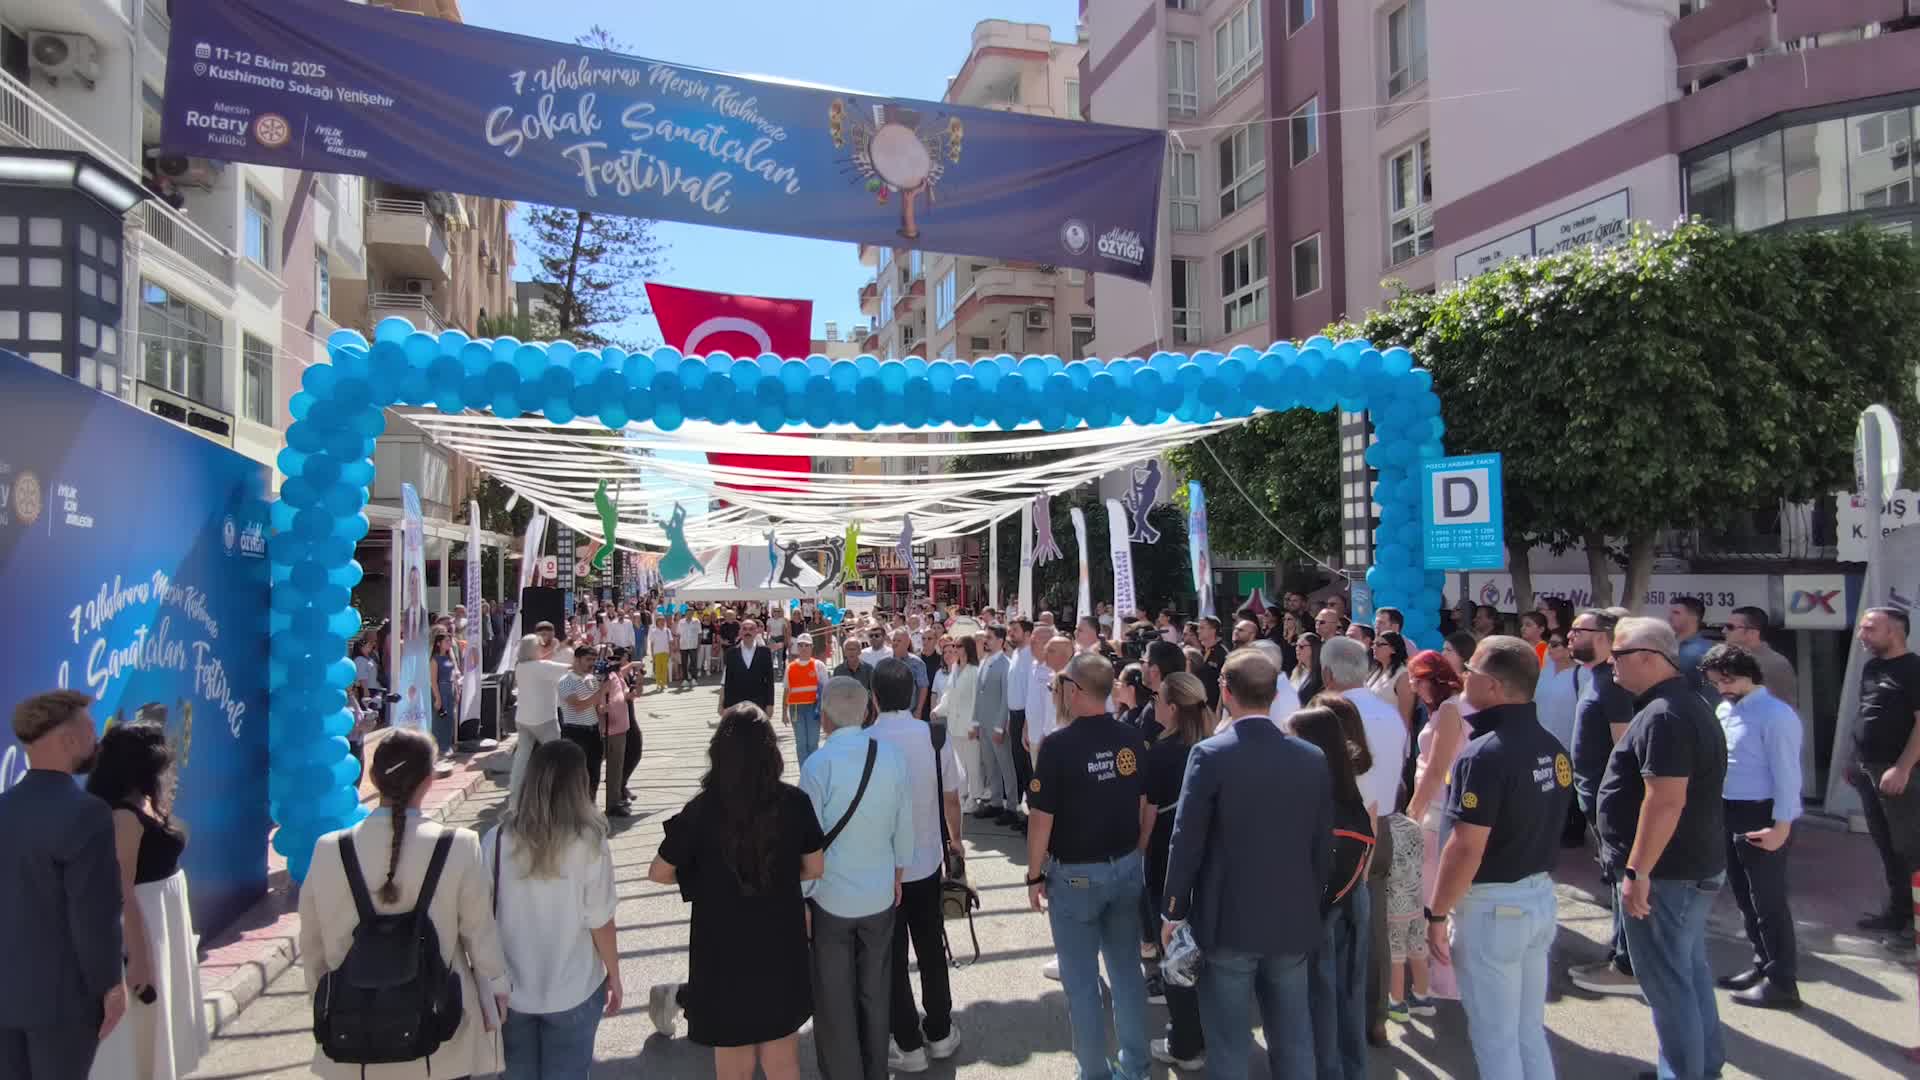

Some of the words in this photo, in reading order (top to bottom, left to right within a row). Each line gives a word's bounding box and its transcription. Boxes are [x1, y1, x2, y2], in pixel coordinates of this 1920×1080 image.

[214, 46, 251, 65] 11-12
[254, 54, 289, 73] Ekim
[291, 61, 327, 79] 2025
[208, 64, 286, 91] Kushimoto
[287, 79, 334, 101] Sokağı
[336, 87, 396, 108] Yenişehir
[648, 63, 711, 101] Mersin
[711, 84, 788, 142] Kushimoto
[185, 110, 249, 137] Rotary
[213, 101, 251, 116] Mersin
[484, 92, 602, 158] Sokak
[207, 131, 248, 147] Kulübü
[561, 140, 734, 215] Festivali
[1441, 475, 1480, 518] D
[1717, 591, 1736, 608] 33
[1087, 759, 1115, 773] Rotary
